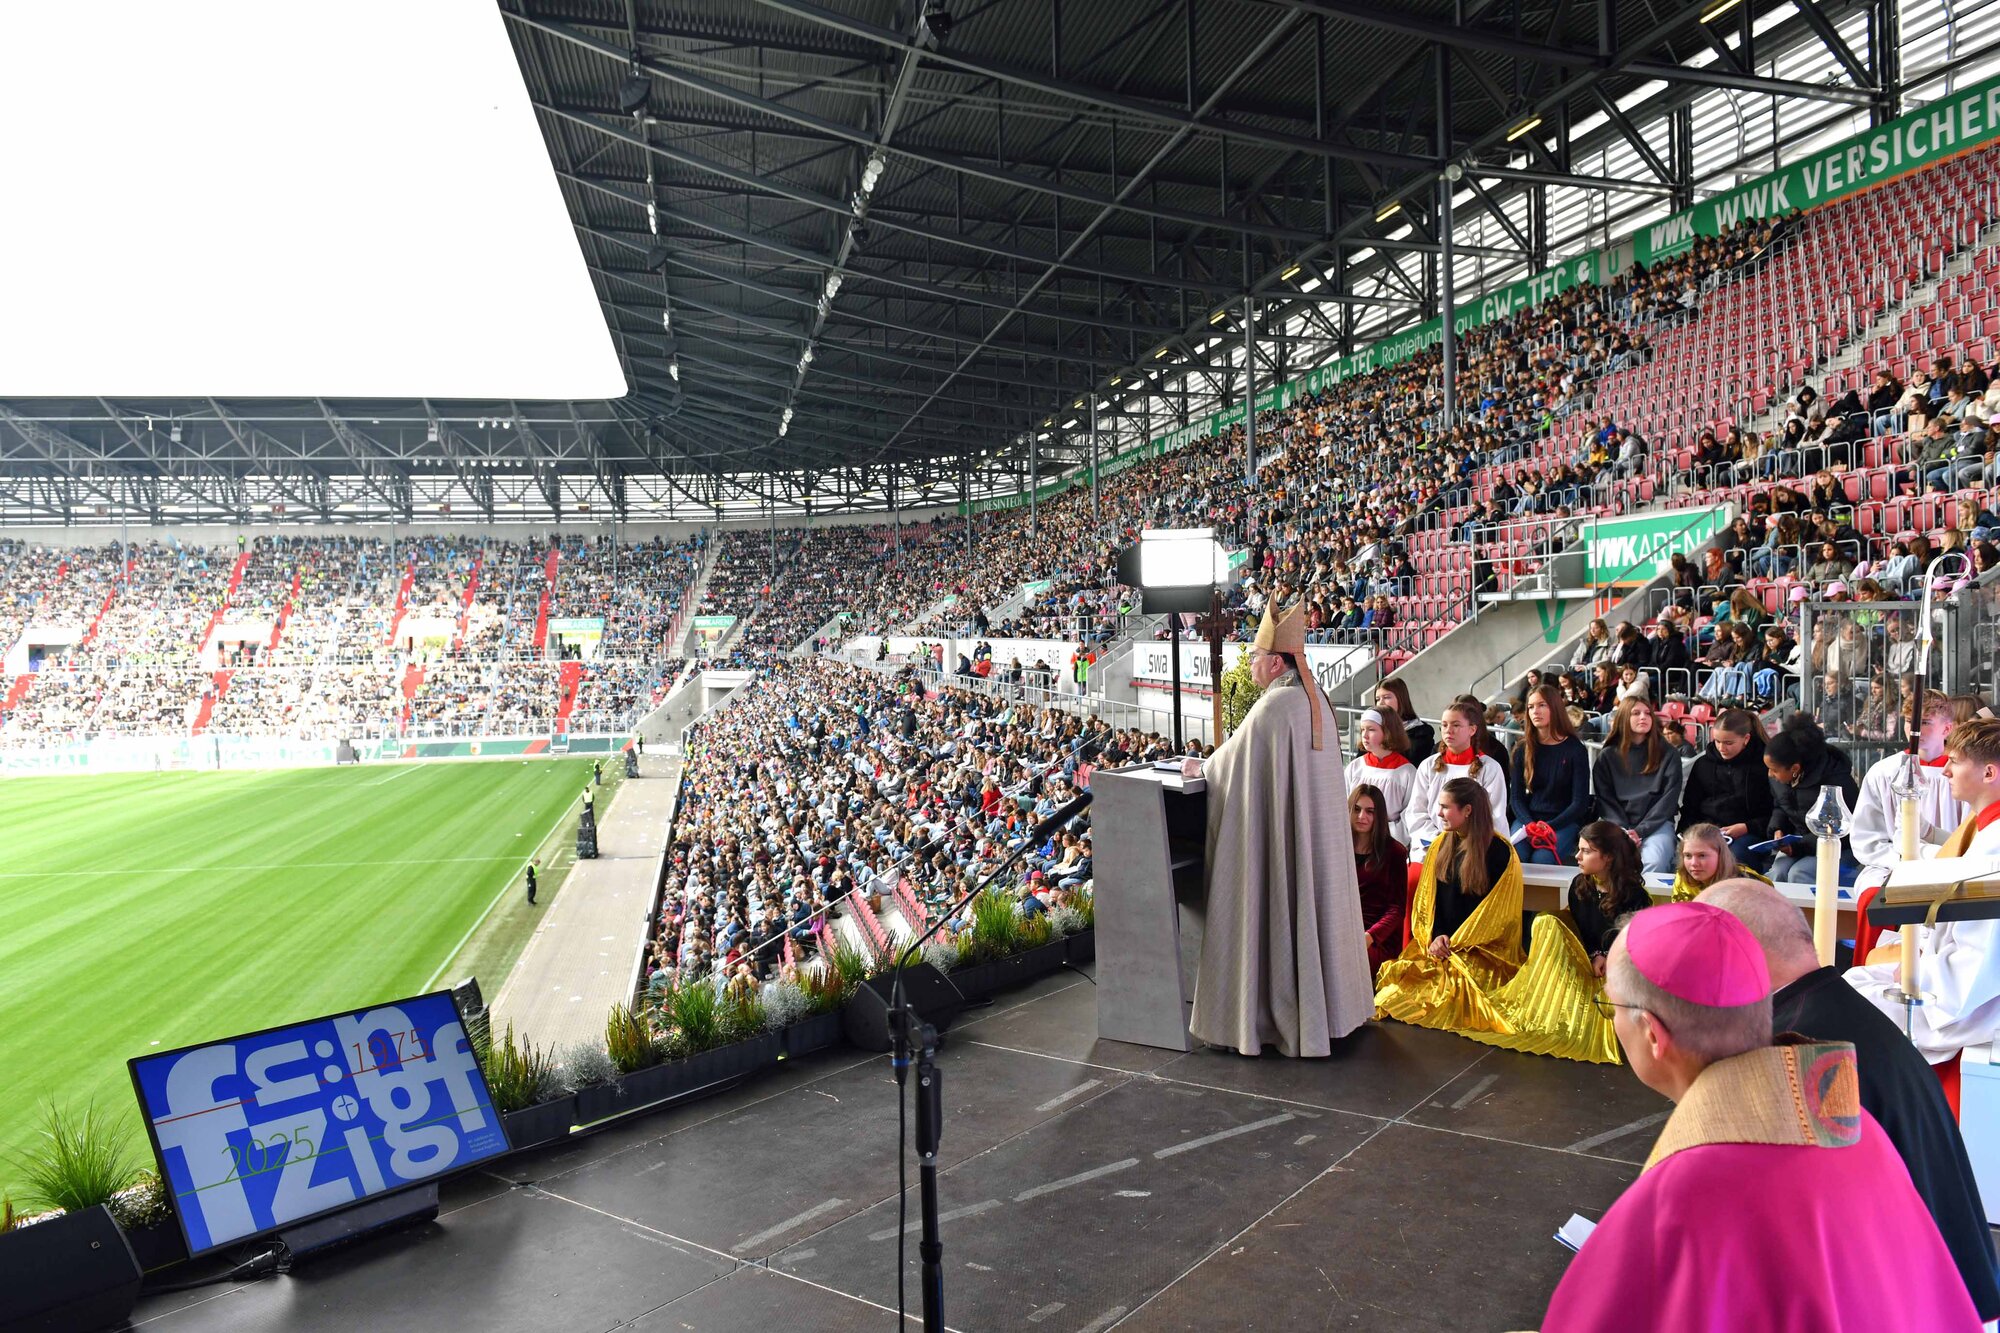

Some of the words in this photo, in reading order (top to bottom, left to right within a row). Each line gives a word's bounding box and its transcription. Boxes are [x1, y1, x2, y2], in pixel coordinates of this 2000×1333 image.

[1714, 174, 1790, 234] WWK
[1651, 211, 1695, 252] WWK
[1164, 418, 1212, 455] KASTNER
[1148, 654, 1168, 674] swa
[1193, 656, 1213, 677] sw
[353, 1027, 430, 1072] 1975
[221, 1125, 315, 1183] 2025
